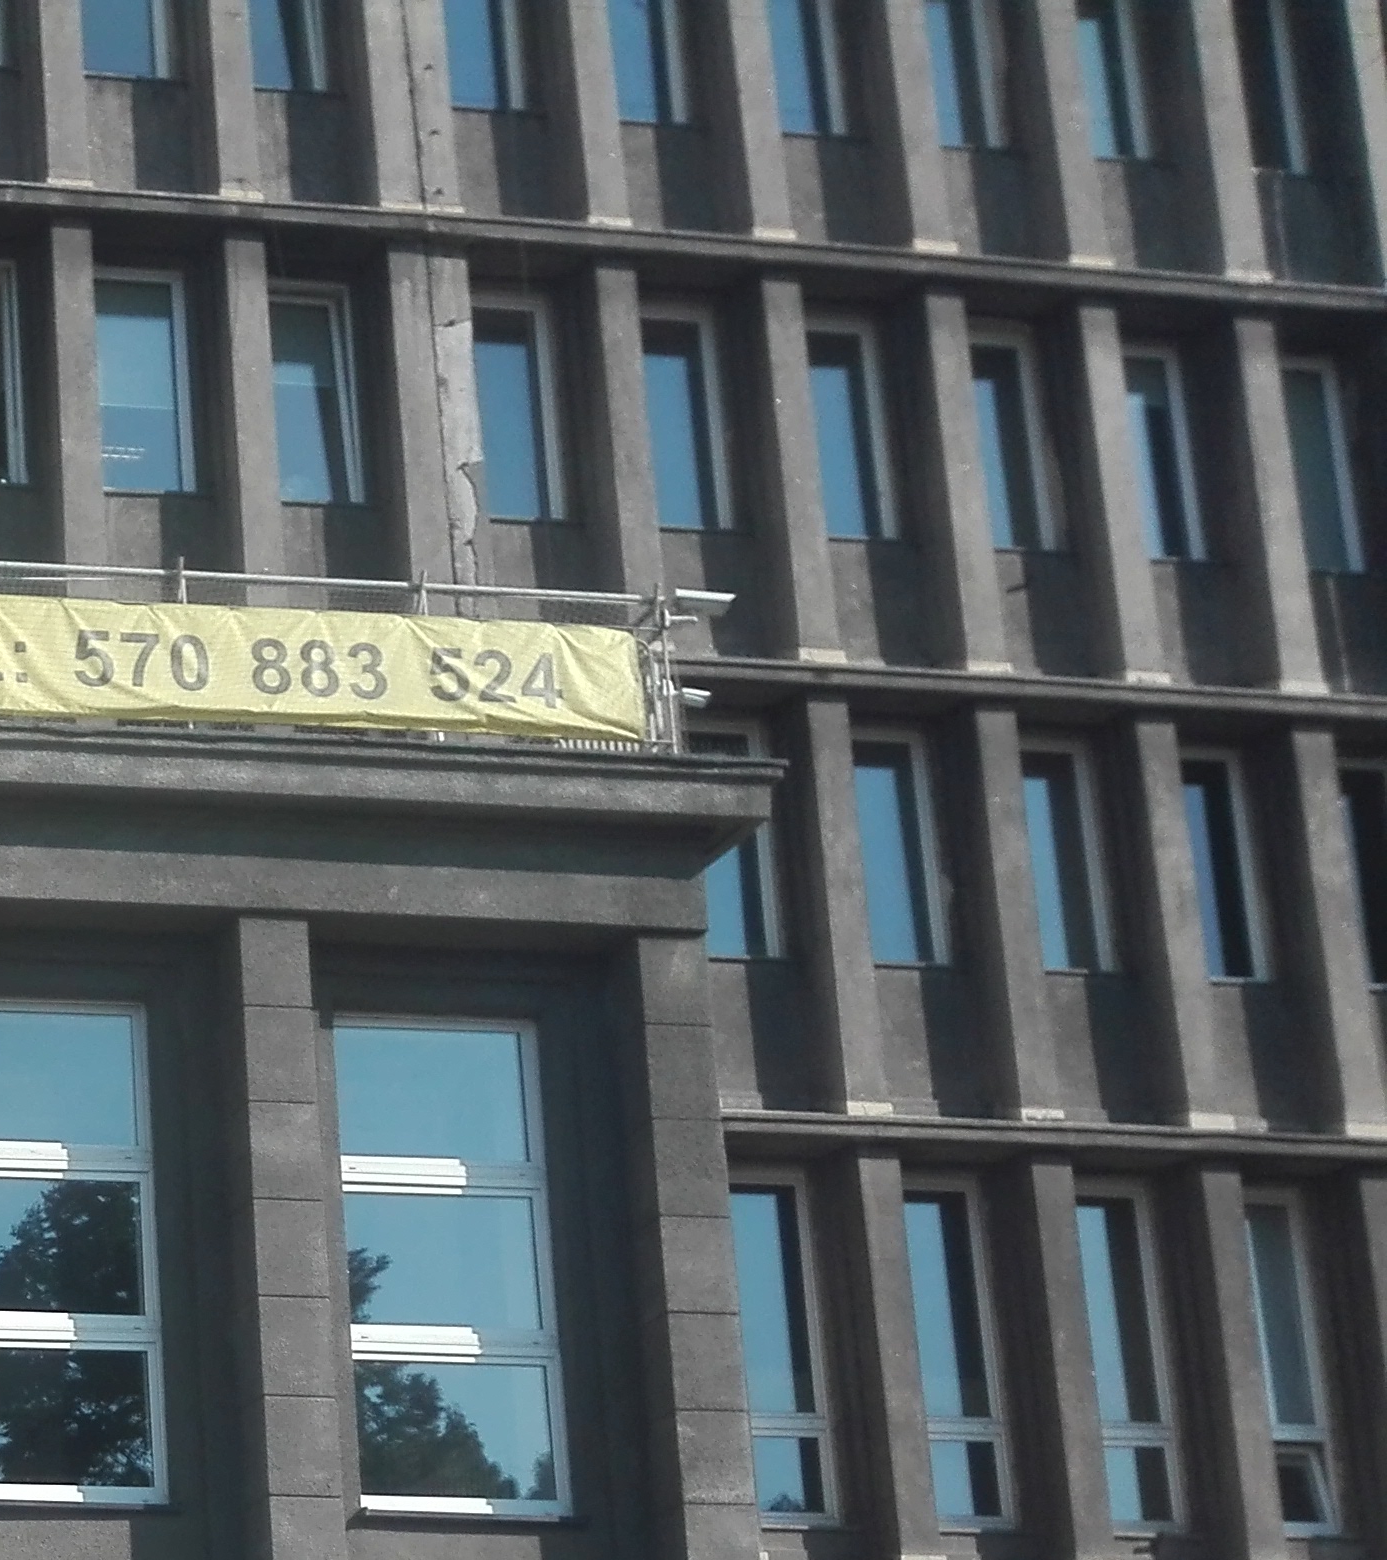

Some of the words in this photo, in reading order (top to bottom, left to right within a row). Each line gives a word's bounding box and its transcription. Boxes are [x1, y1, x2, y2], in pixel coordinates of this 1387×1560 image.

[74, 630, 209, 692] 570
[251, 638, 388, 701] 883
[430, 647, 563, 709] 524
